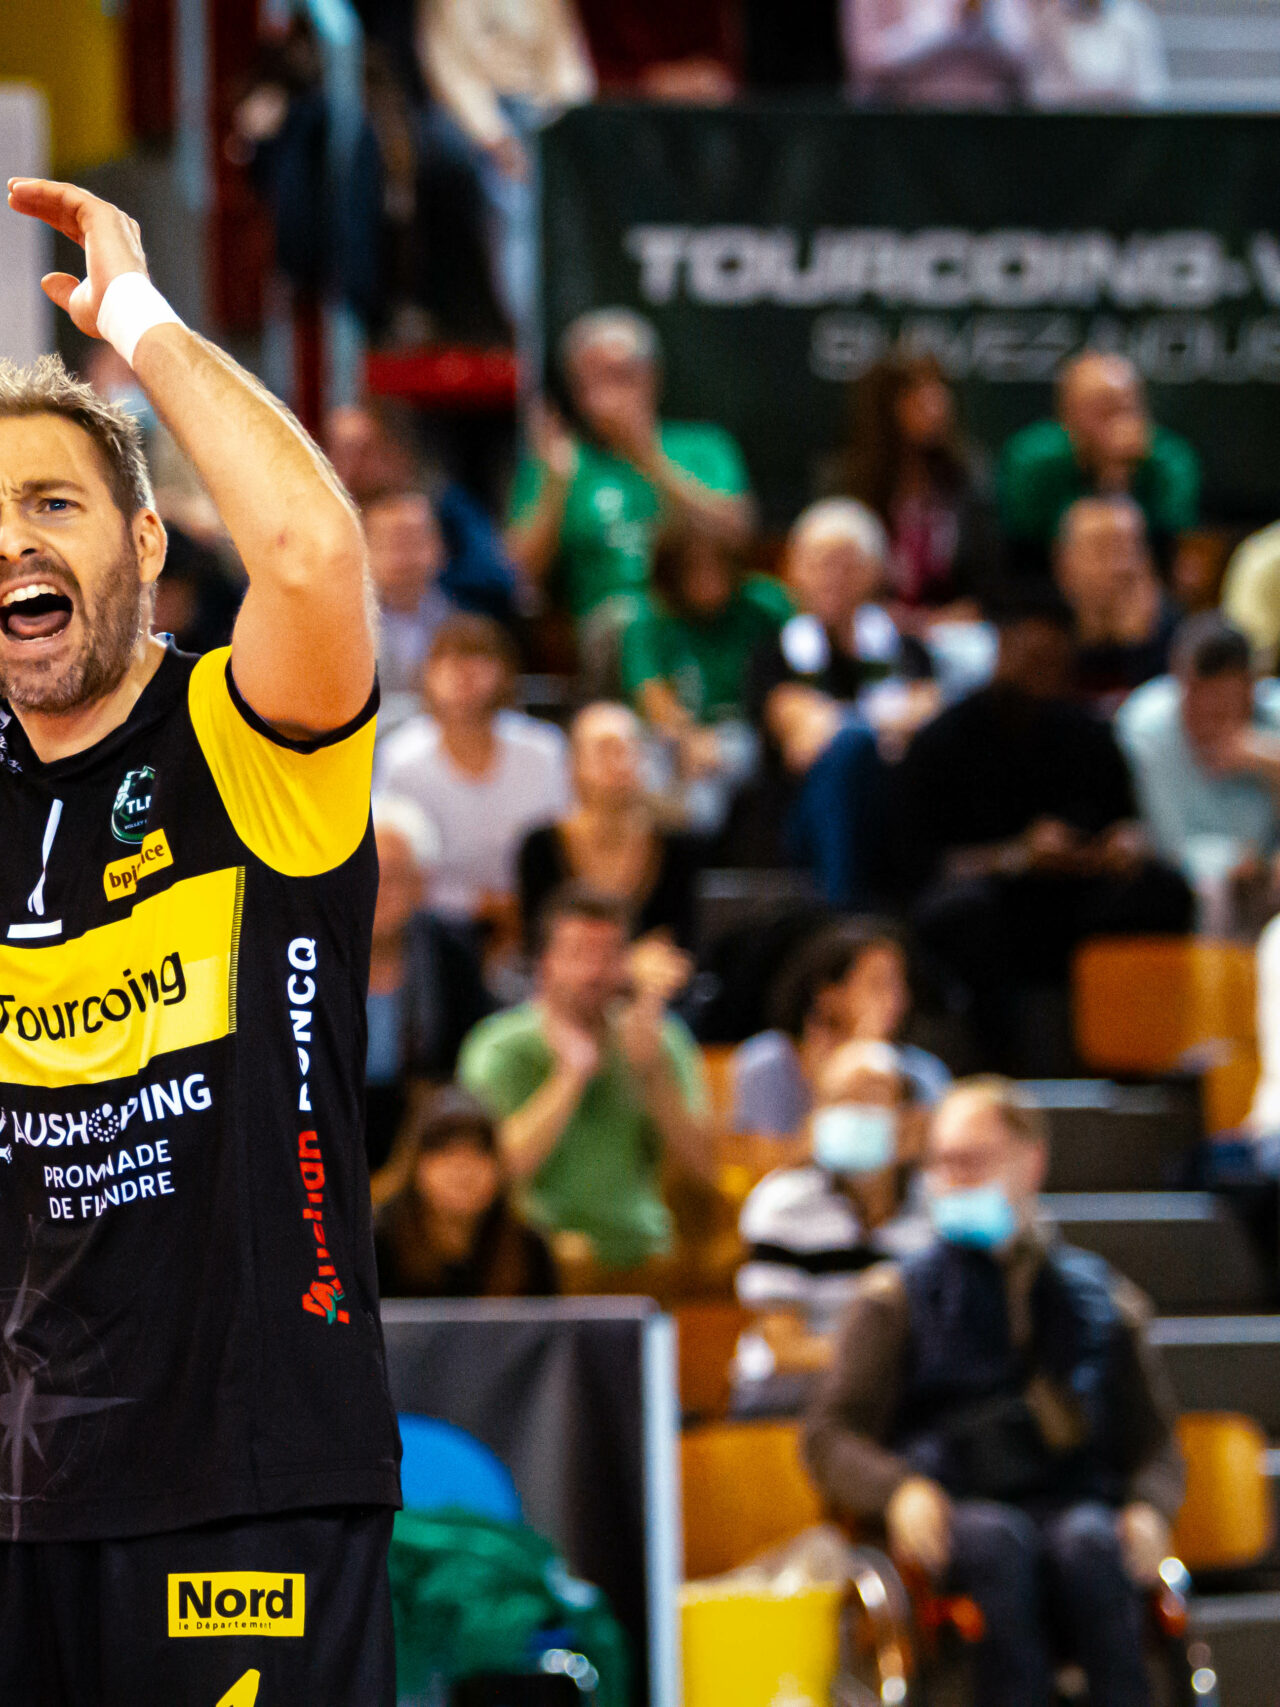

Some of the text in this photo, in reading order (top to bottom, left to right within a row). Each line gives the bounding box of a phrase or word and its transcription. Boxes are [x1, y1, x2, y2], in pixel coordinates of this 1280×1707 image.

[49, 1196, 75, 1219] DE
[178, 1578, 294, 1620] Nord
[178, 1620, 272, 1632] le Département
